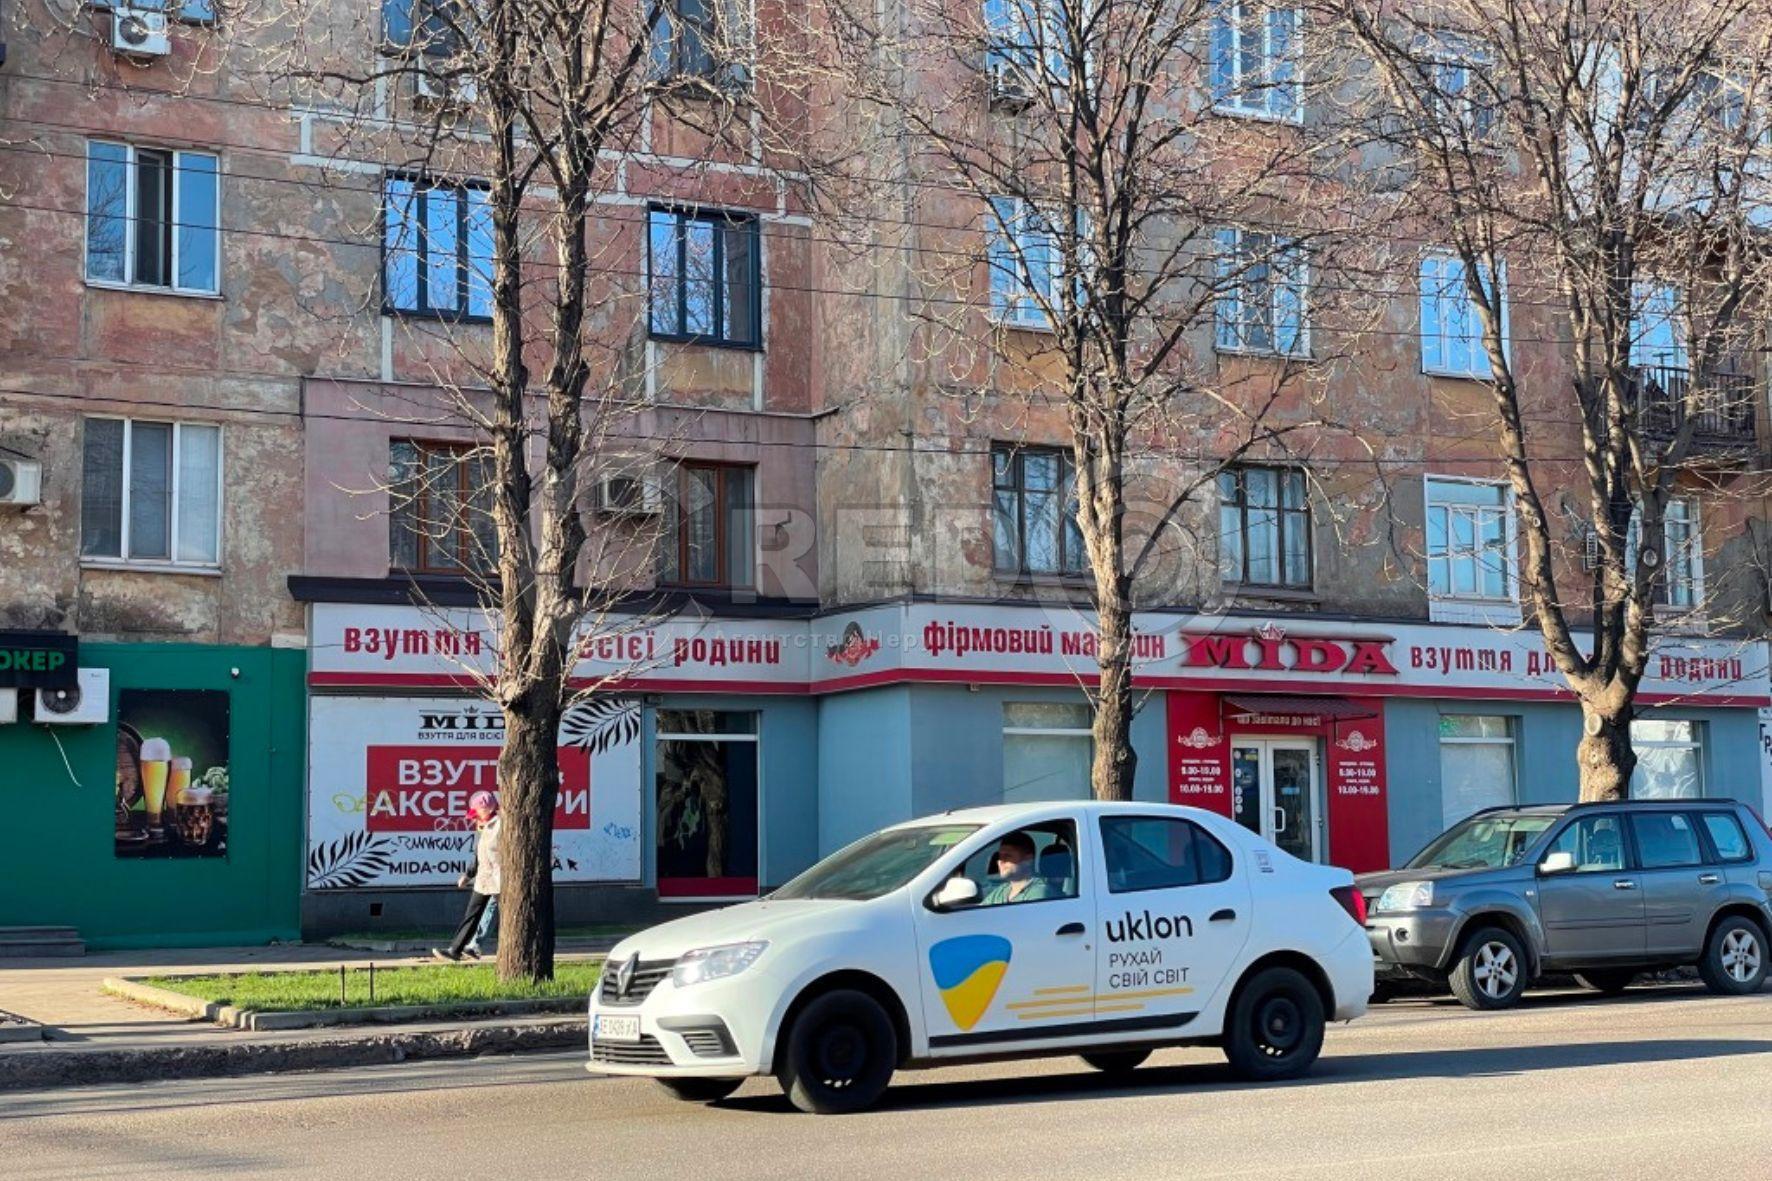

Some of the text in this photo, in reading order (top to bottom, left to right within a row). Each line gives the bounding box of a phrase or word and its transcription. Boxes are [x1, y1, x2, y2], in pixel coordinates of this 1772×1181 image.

[344, 627, 480, 660] взуття
[674, 636, 780, 667] родини
[923, 620, 1166, 658] фірмовий маин
[1180, 634, 1401, 677] MIDA
[1410, 645, 1557, 677] взуття дл
[419, 714, 506, 730] MID
[418, 731, 454, 741] ВЗУТТЯ
[456, 731, 477, 742] ДЛЯ
[399, 759, 500, 786] ВЗУТ
[370, 789, 588, 817] АКСЕИ
[1105, 909, 1193, 942] uklon
[1109, 946, 1162, 968] РУХАЙ
[1108, 967, 1190, 988] СВІЙ СВІТ
